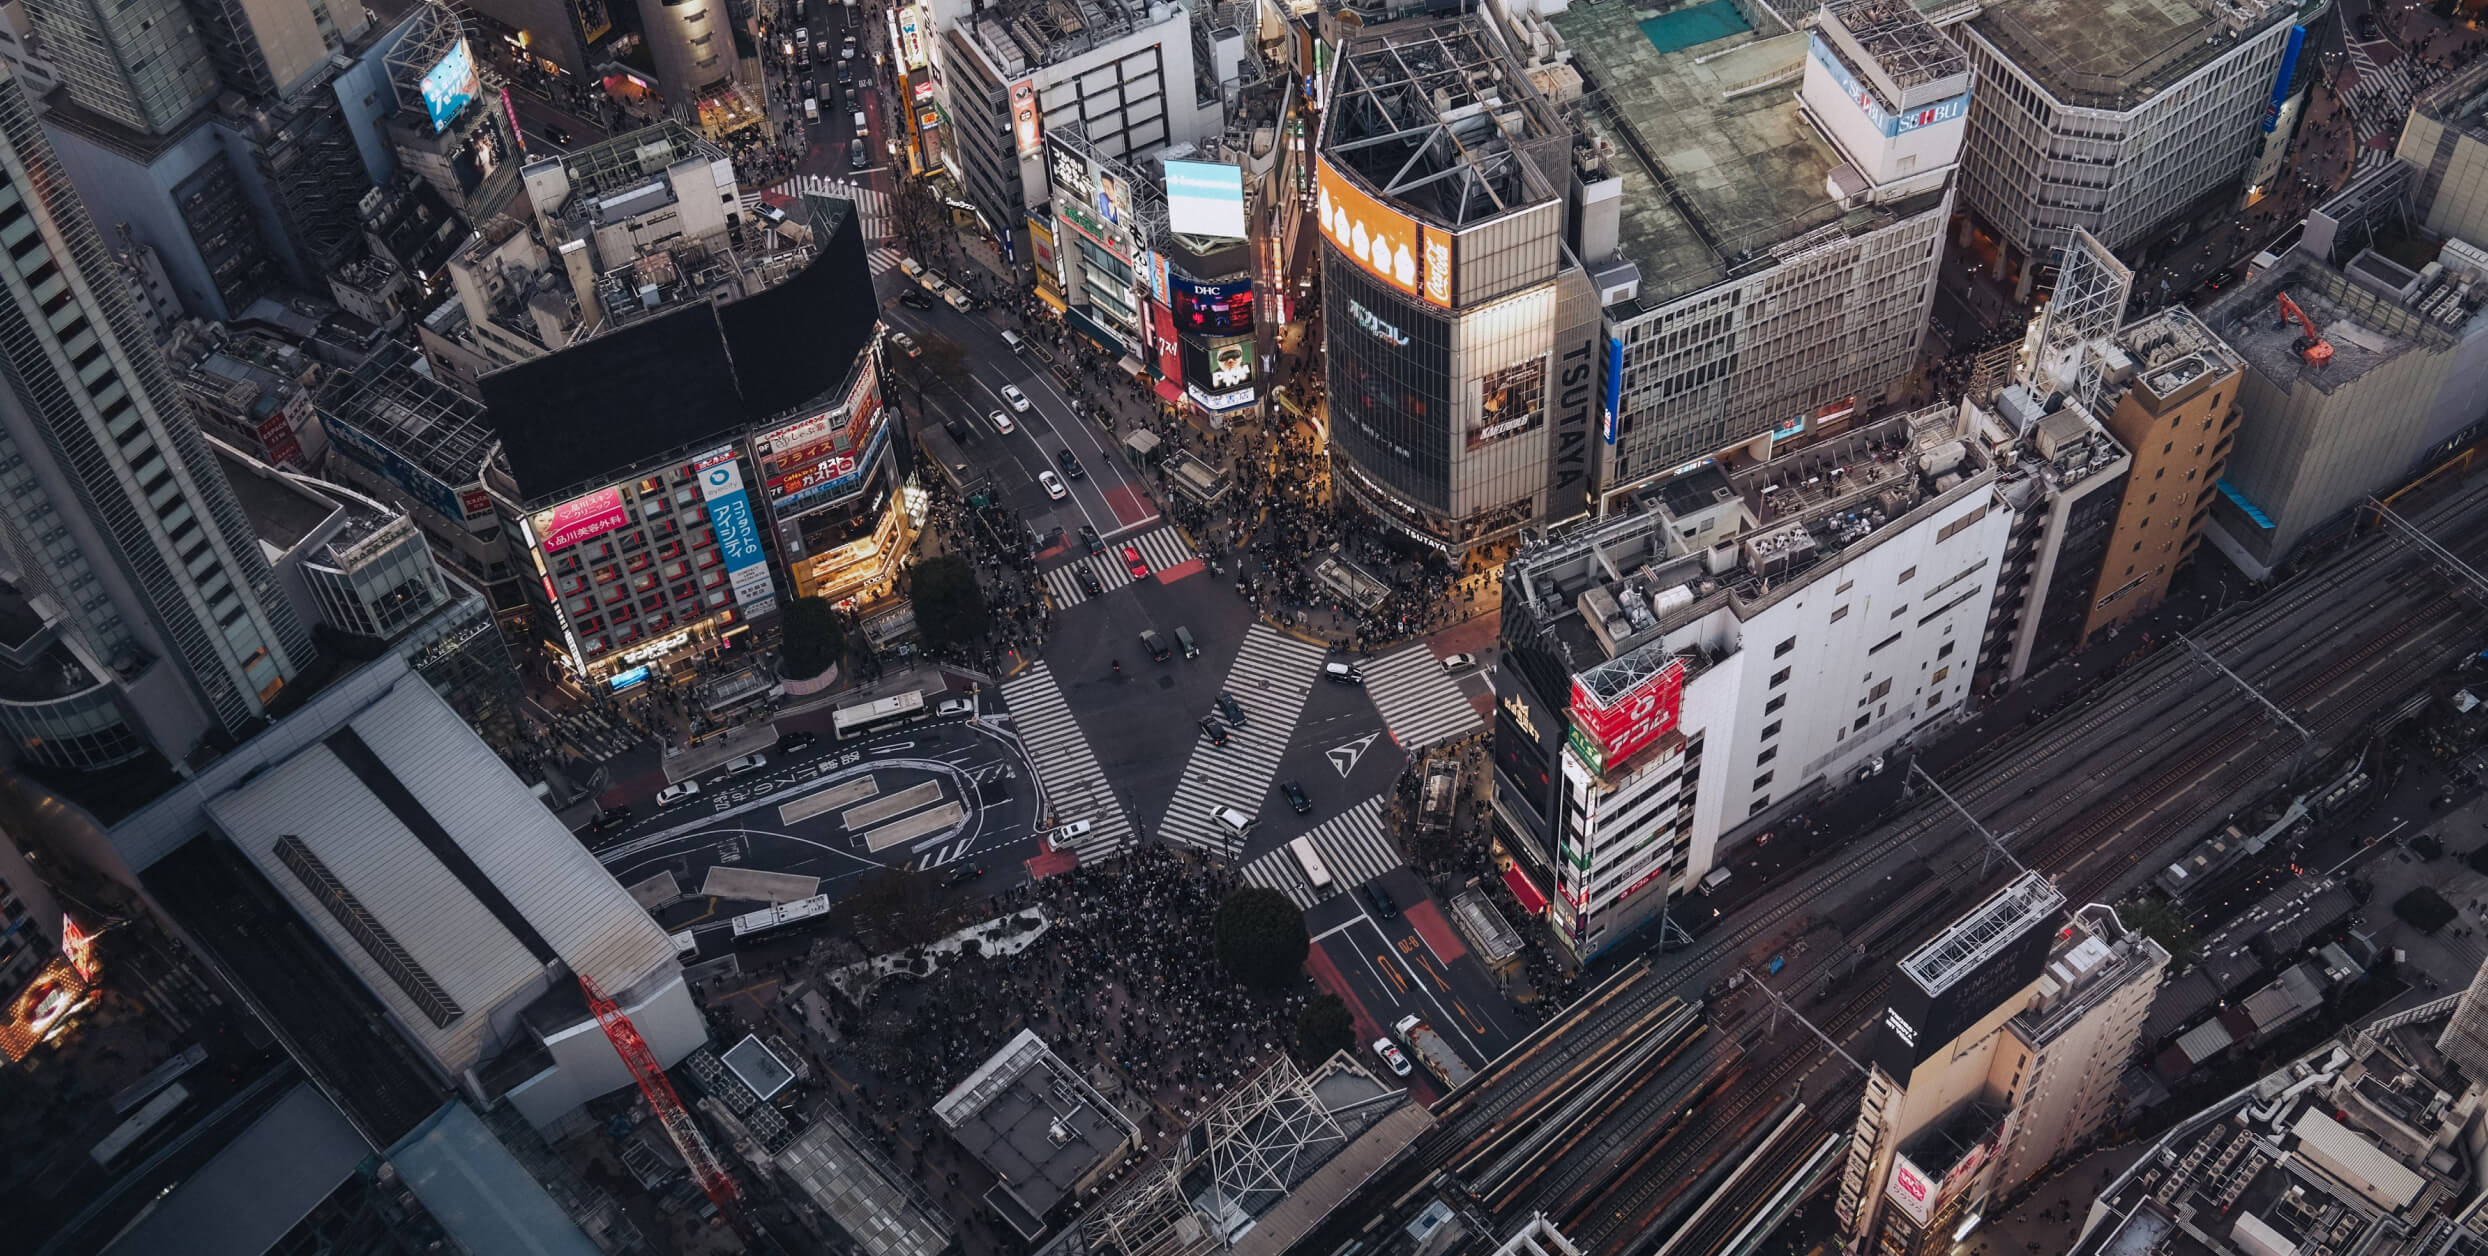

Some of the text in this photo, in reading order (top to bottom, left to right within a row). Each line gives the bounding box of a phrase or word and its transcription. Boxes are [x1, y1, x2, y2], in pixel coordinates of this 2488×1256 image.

[1848, 80, 1884, 130] SEIBU
[1898, 101, 1958, 132] SEIBU
[1194, 284, 1221, 296] DHC
[1557, 340, 1592, 490] TSUTAYA
[758, 443, 771, 454] 9F
[770, 486, 784, 497] 7F
[802, 467, 836, 487] ガスト
[555, 515, 622, 546] 品川美容外科
[713, 504, 743, 559] アイシティ
[731, 499, 757, 555] コンタクトの
[1404, 527, 1448, 553] TSUTAYA
[1608, 707, 1672, 755] アコム
